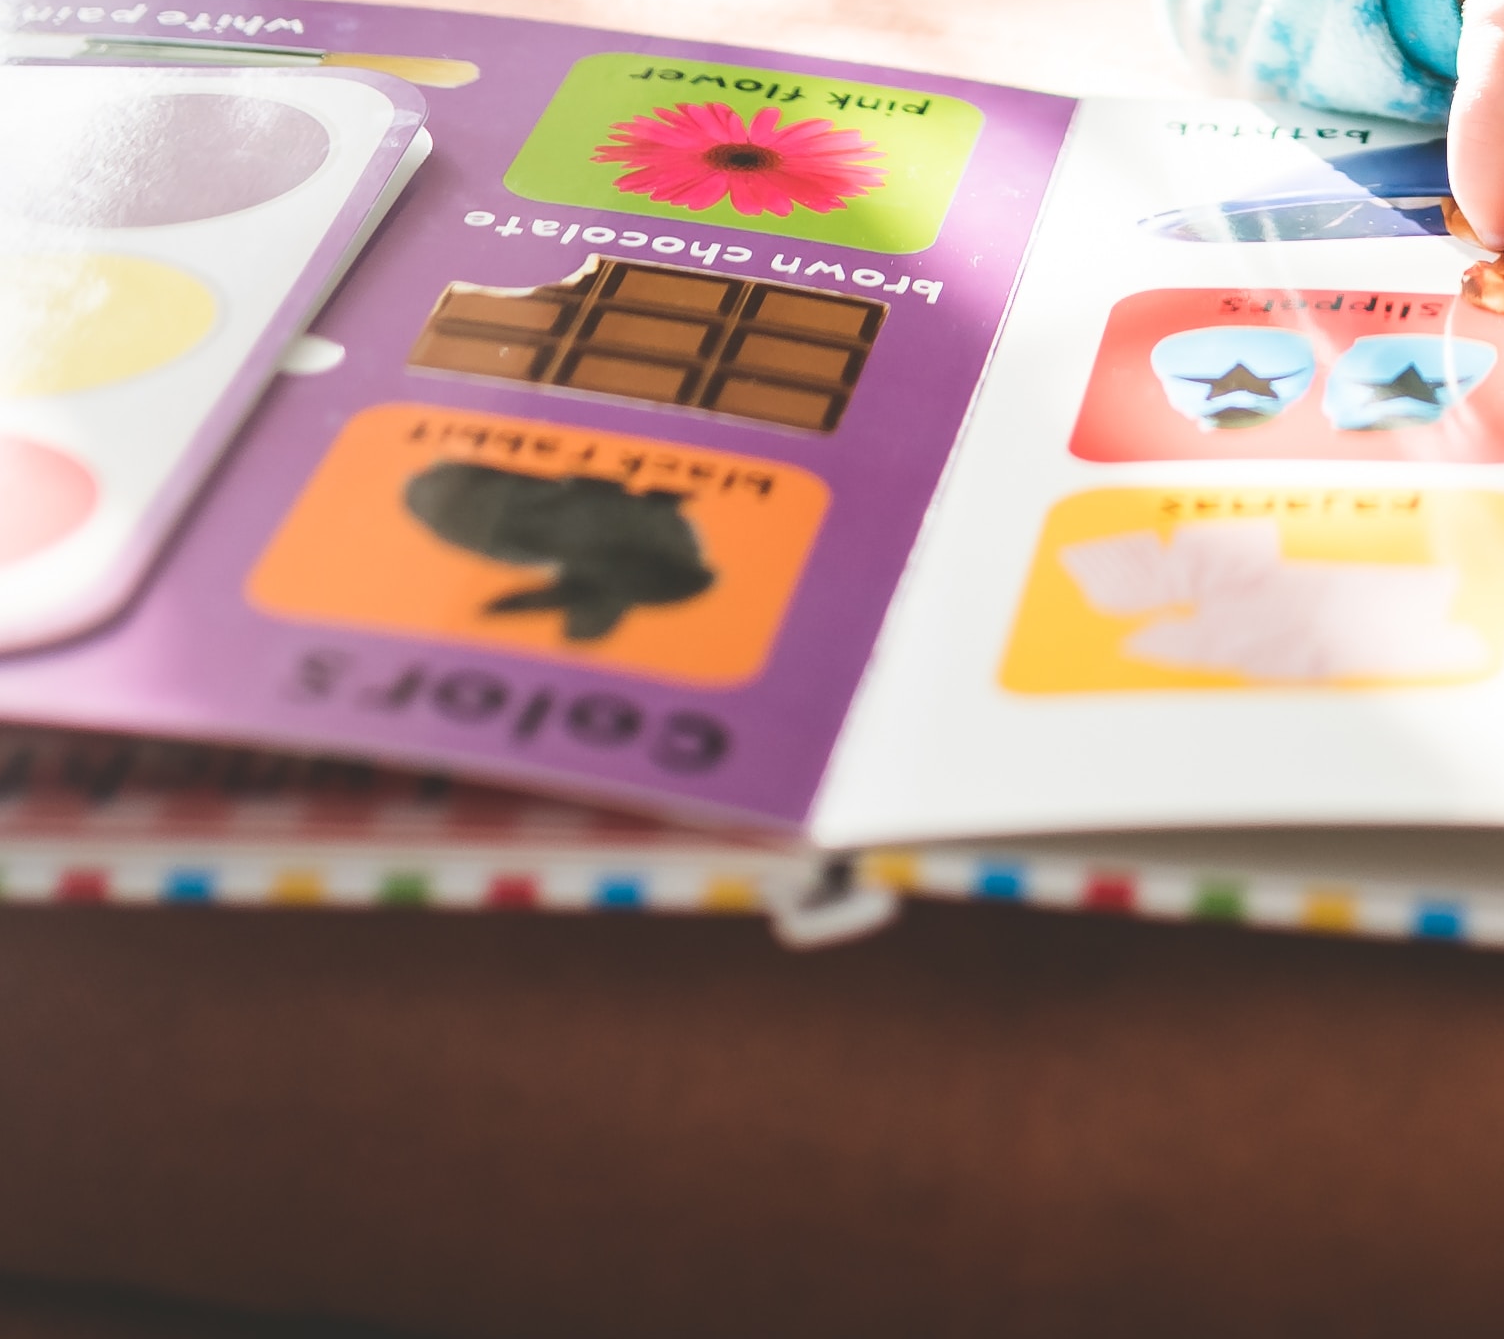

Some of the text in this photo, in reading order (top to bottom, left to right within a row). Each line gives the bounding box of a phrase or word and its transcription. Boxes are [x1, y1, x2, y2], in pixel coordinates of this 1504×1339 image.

[18, 2, 304, 37] white pain
[629, 67, 932, 116] pink flower
[1166, 121, 1373, 145] bathtub
[463, 210, 944, 304] brown chocolate
[1219, 293, 1444, 319] slippers
[405, 418, 779, 501] black rabbit
[279, 647, 736, 778] Colors
